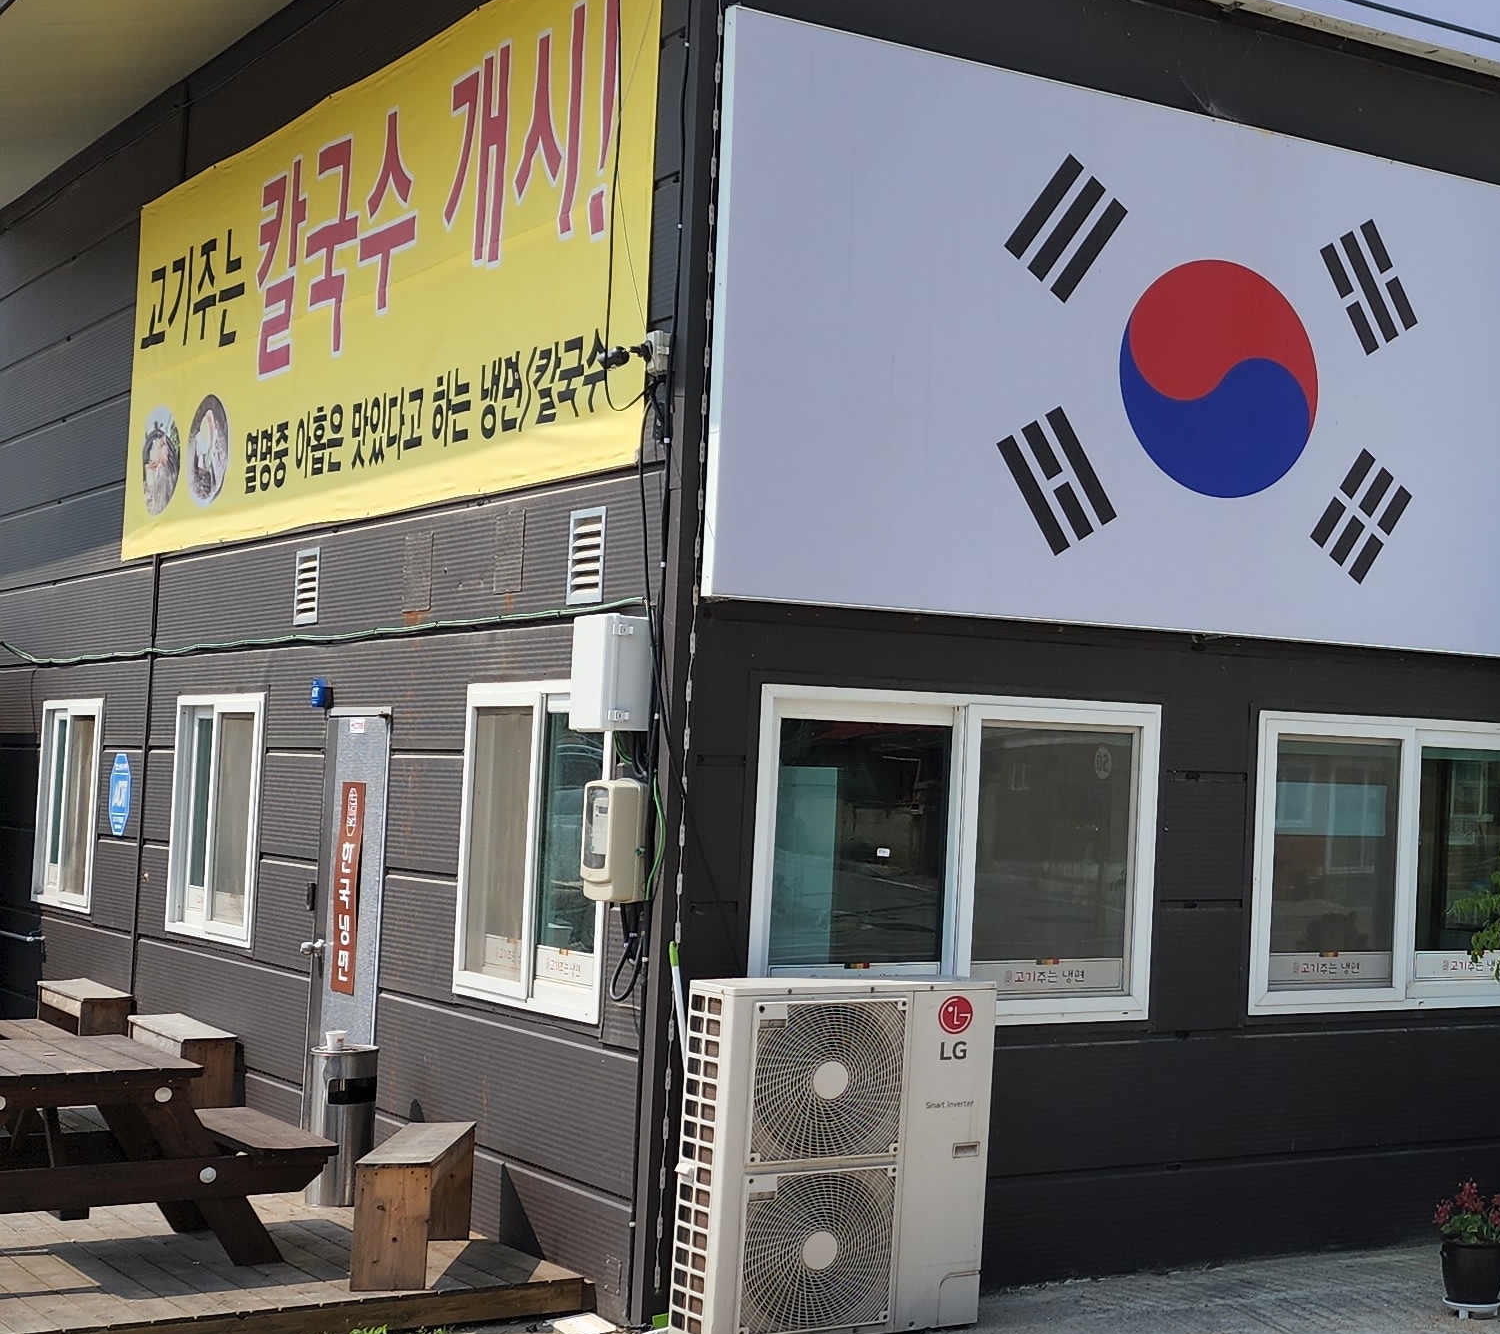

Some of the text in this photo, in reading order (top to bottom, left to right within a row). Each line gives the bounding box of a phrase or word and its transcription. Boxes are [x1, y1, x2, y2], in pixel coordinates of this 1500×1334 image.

[141, 229, 245, 350] 고기주는
[256, 107, 418, 380] 칼국수
[244, 327, 606, 494] 열명중 아홉은 맛있다고 하는 냉면/칼국수
[1301, 961, 1360, 975] 고기주는 냉면
[1015, 970, 1085, 983] 고기주는 냉면
[940, 1041, 967, 1060] LG
[925, 1100, 974, 1109] Smart Inverter
